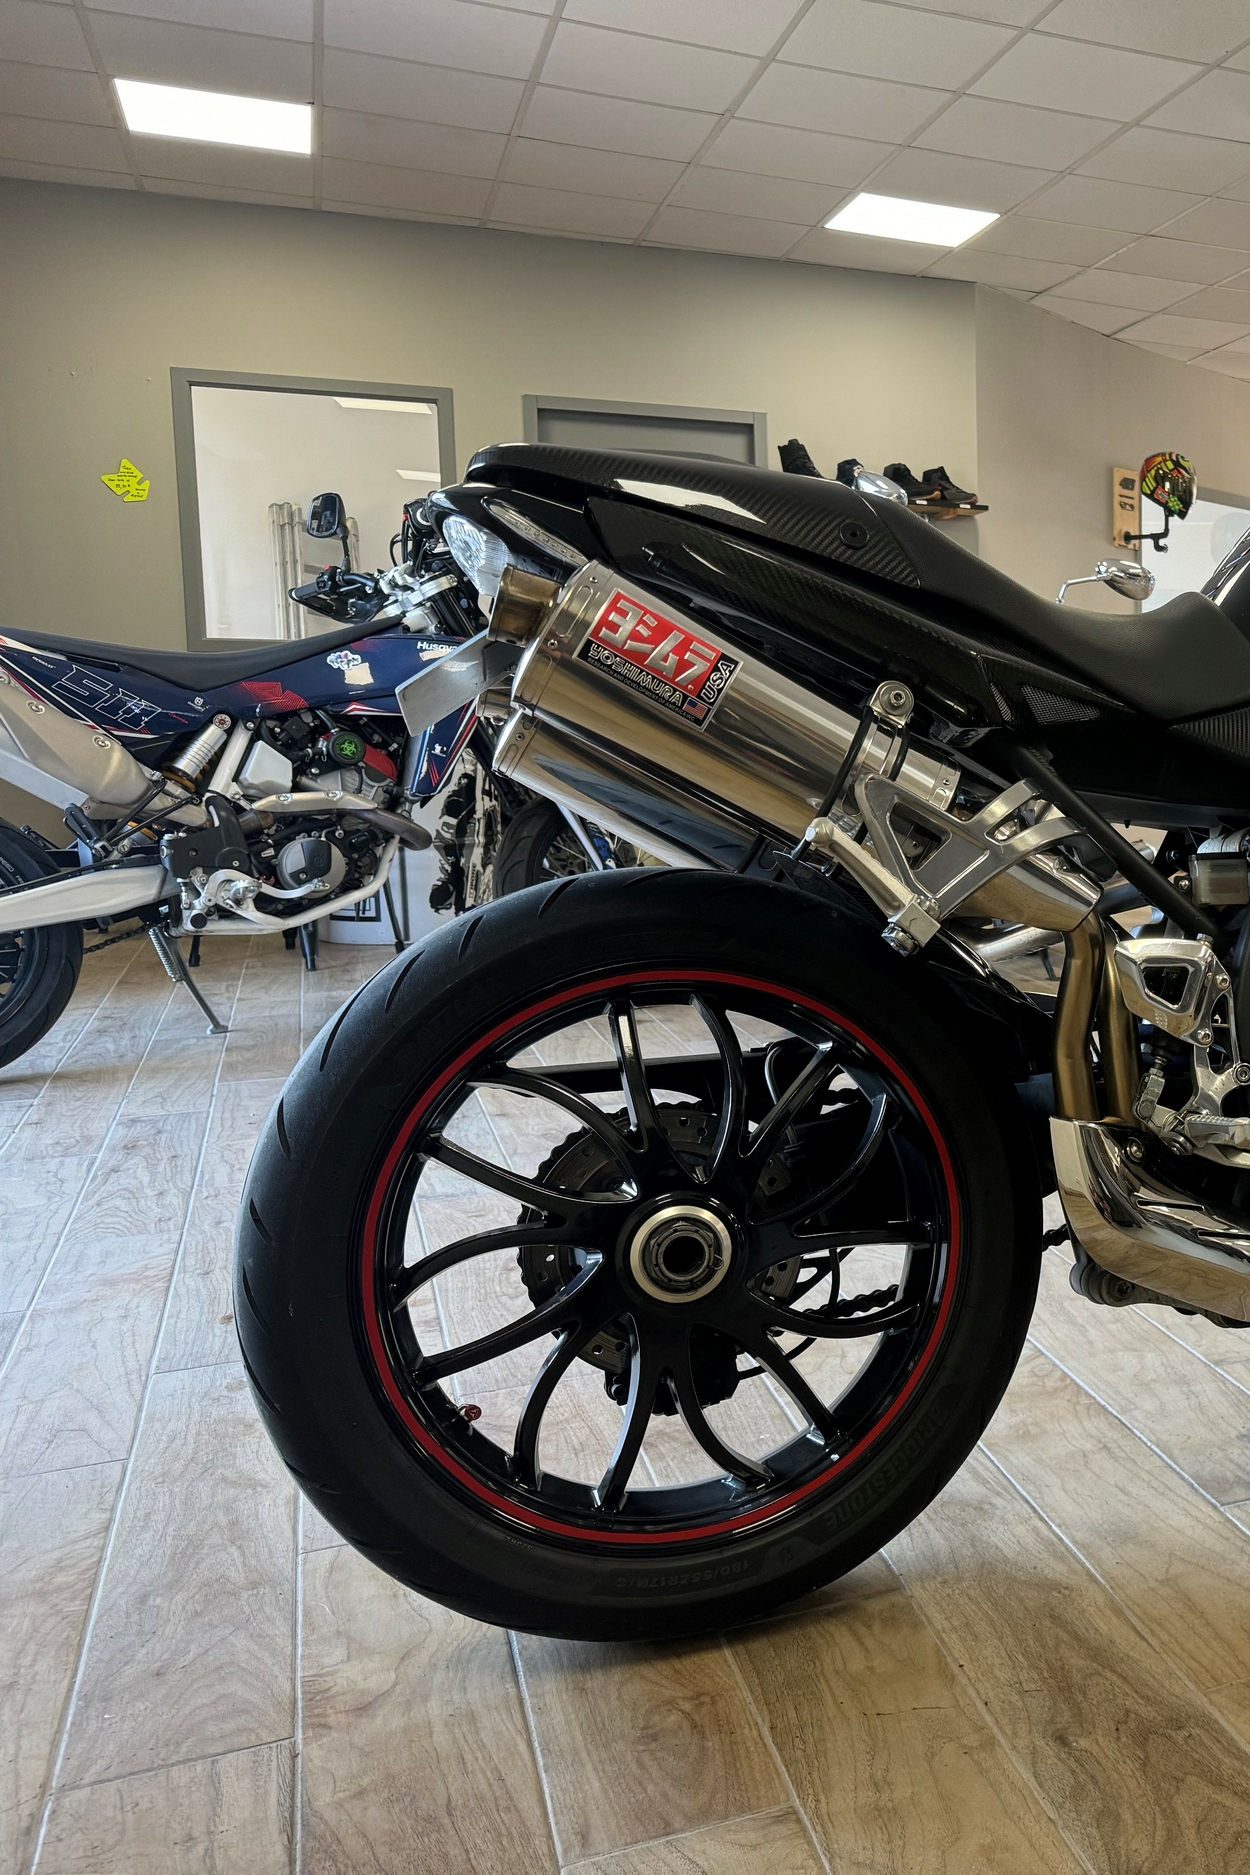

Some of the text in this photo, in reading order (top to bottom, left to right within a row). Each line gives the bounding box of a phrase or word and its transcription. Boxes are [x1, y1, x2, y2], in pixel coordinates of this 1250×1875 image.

[598, 598, 717, 687] ヨシムラ
[586, 657, 614, 675] RESEARCH
[612, 672, 624, 681] AND
[622, 677, 659, 701] DEVELOPMENT
[664, 701, 687, 717] AMERICA
[588, 643, 684, 707] YOSHIMURA
[701, 660, 735, 703] USA
[822, 1400, 950, 1532] BRIDGESTONE
